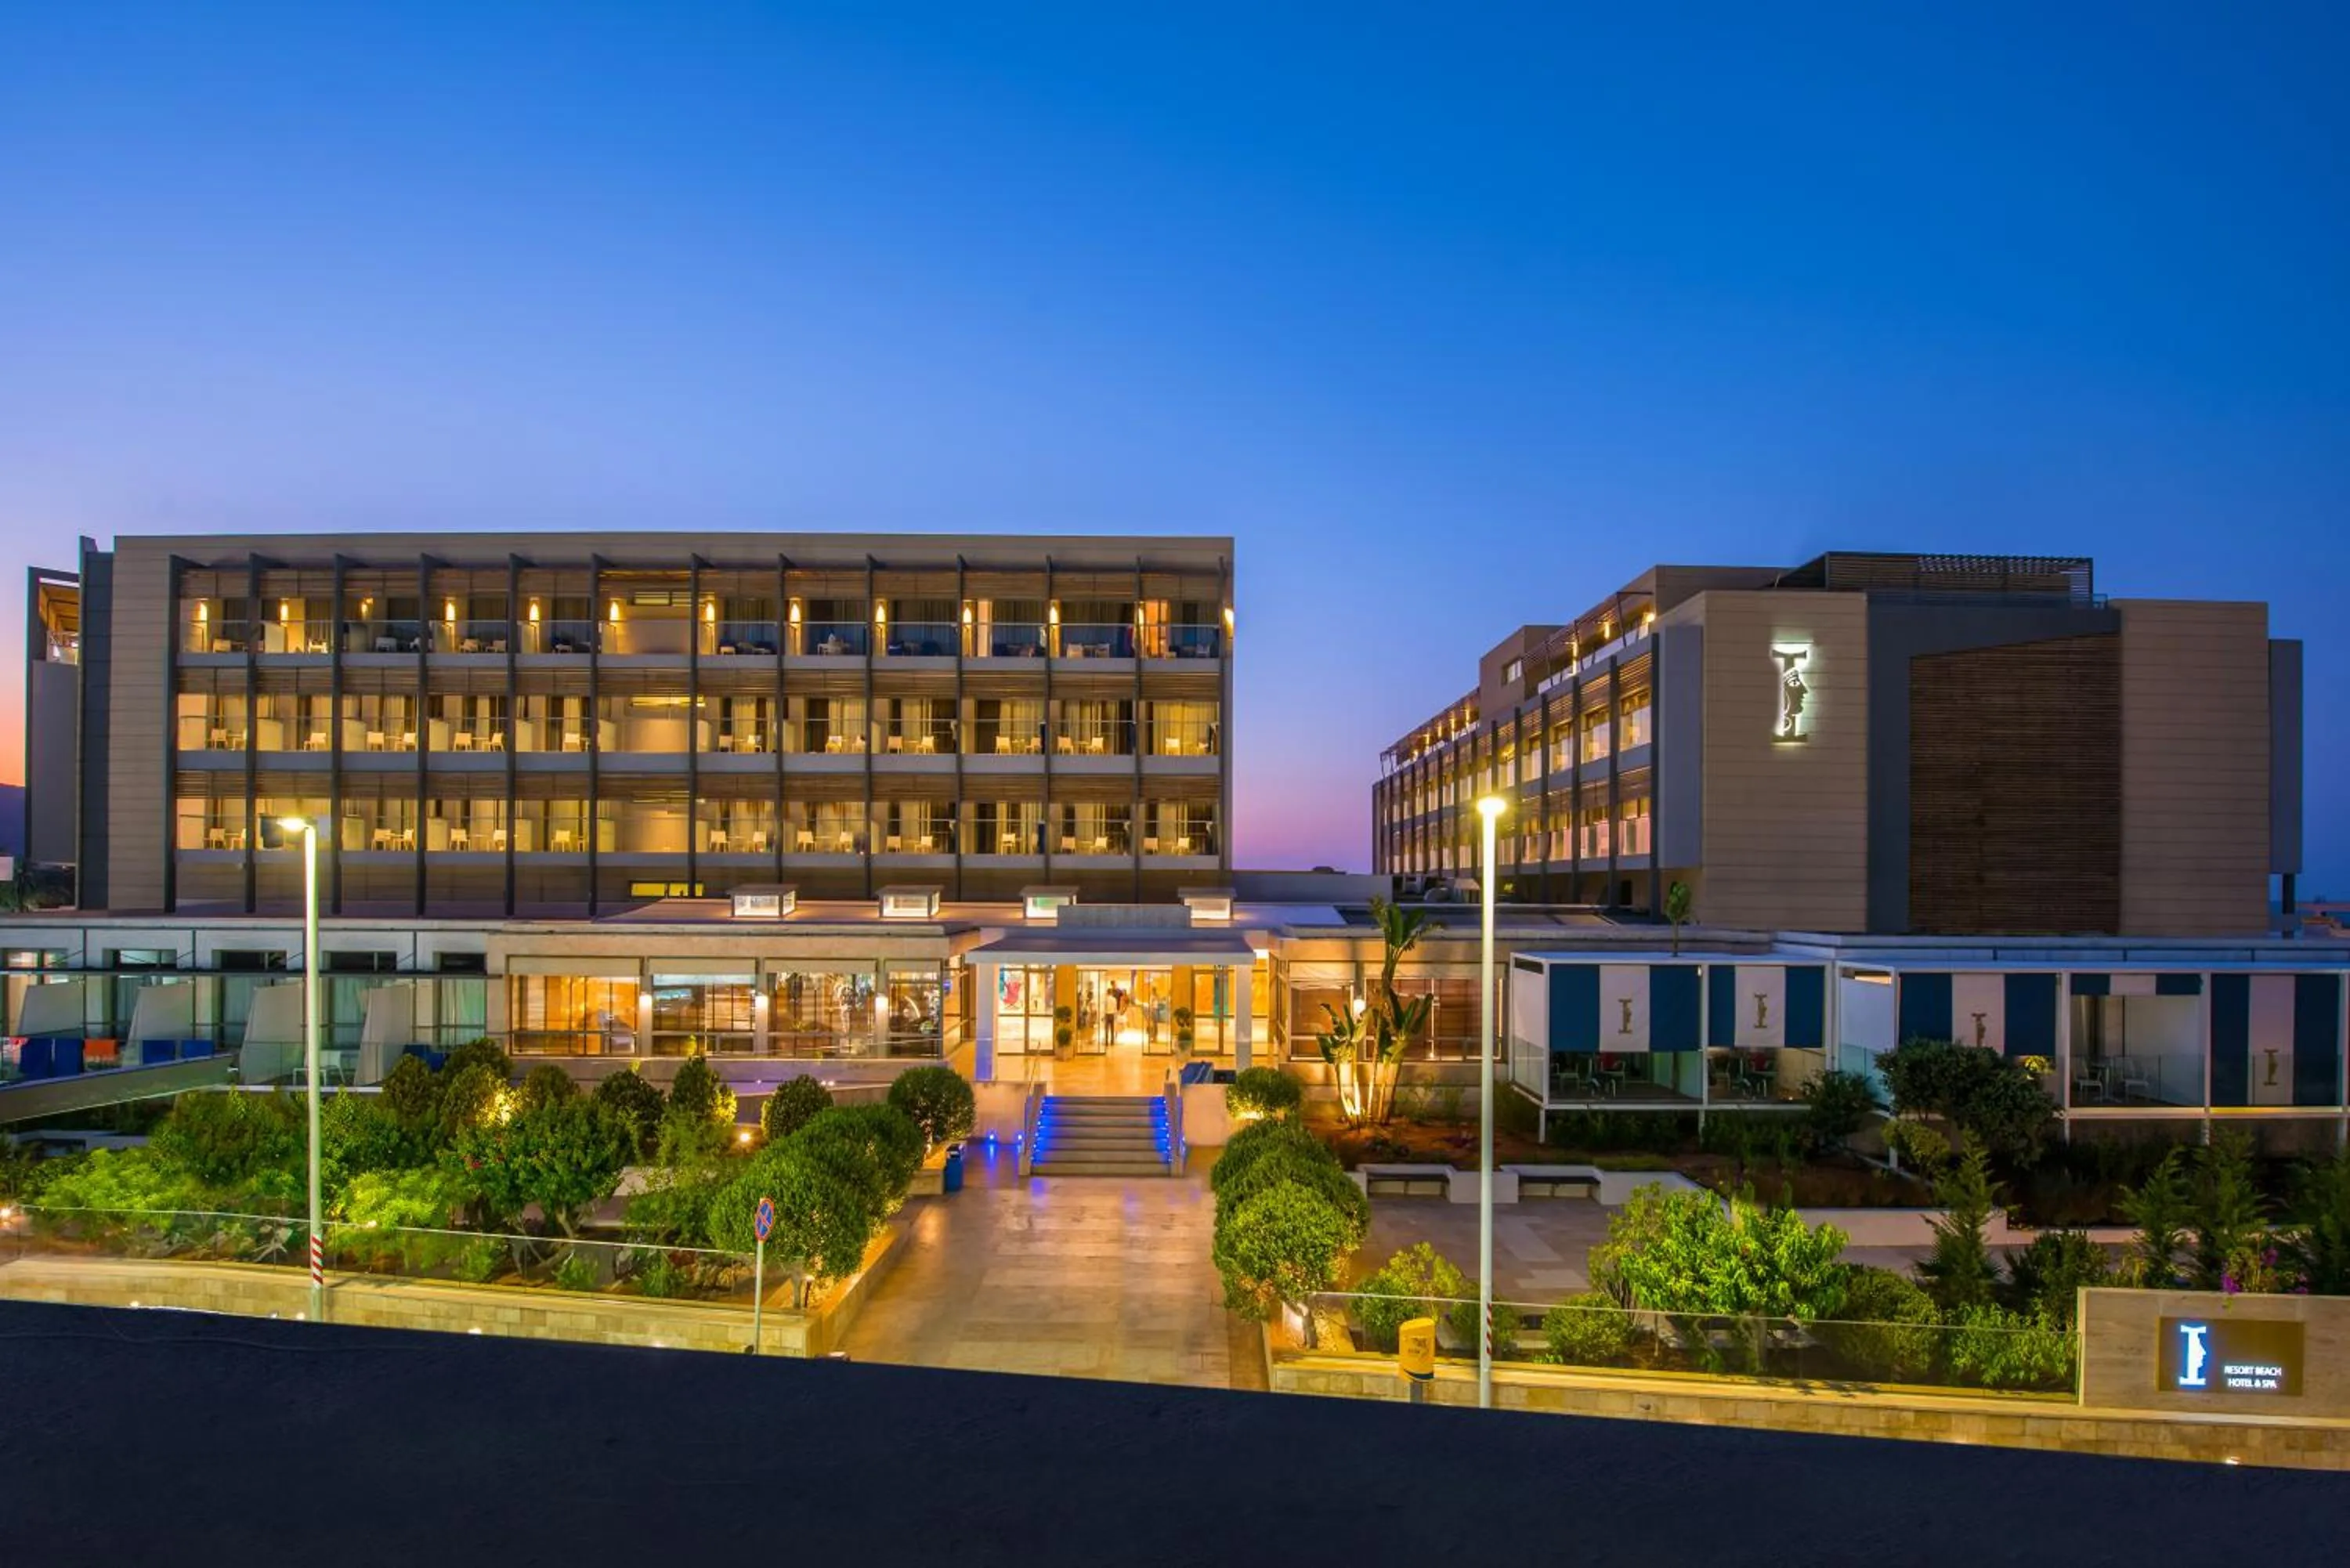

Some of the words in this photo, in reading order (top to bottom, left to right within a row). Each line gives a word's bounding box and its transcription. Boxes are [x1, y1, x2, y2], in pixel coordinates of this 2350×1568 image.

[2224, 1365, 2254, 1375] RESORT
[2254, 1367, 2282, 1376] BEACH
[2227, 1378, 2253, 1388] HOTEL
[2254, 1378, 2261, 1389] &
[2261, 1379, 2277, 1389] SPA
